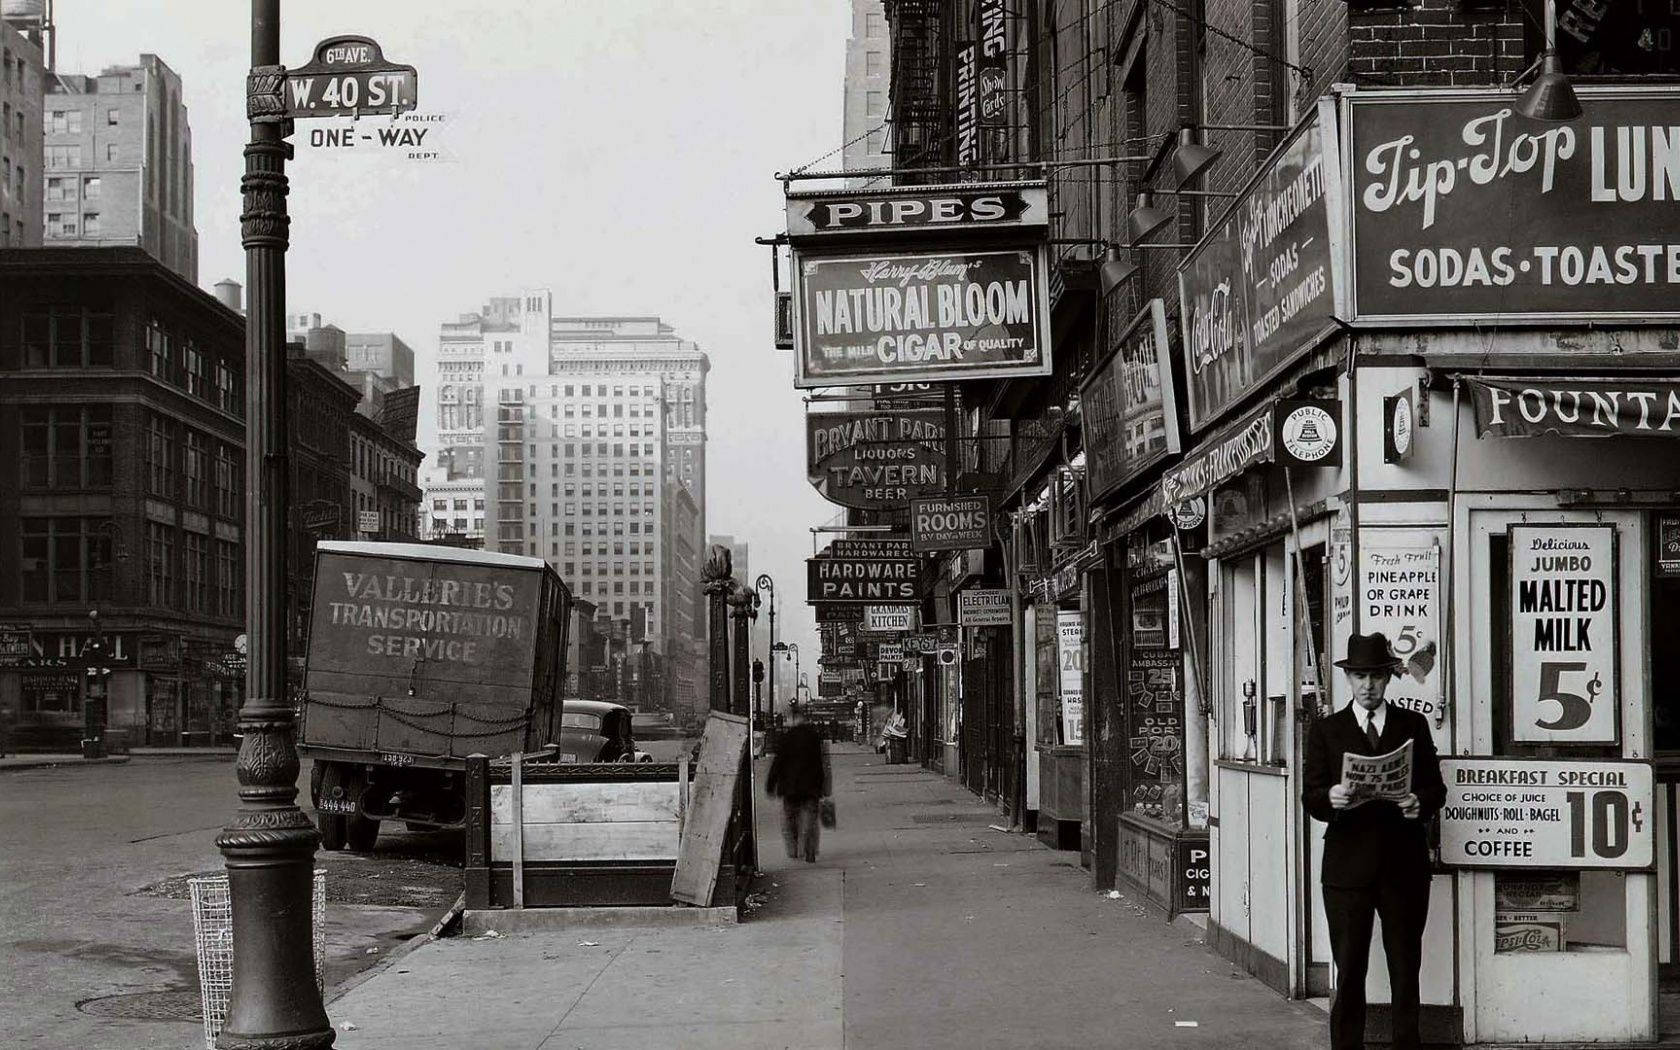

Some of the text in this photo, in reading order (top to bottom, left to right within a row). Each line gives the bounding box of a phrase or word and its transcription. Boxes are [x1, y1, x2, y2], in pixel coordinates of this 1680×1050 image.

[982, 0, 1005, 58] ING
[346, 47, 371, 64] AVE.
[290, 75, 409, 109] W. 40 ST.
[958, 45, 977, 166] PRINTING
[1363, 108, 1680, 230] Tip-Top LUN
[825, 197, 1006, 227] PIPES
[1271, 242, 1298, 288] SODAS
[1281, 266, 1326, 323] SANDWICHES
[815, 279, 1029, 335] NATURAL BLOOM
[876, 331, 963, 363] CIGAR
[978, 338, 1024, 351] QUALITY
[1291, 408, 1328, 421] PUBLIC
[1488, 386, 1680, 431] FOUNTA
[814, 417, 893, 465] BRYANT
[1286, 438, 1334, 459] TELEPHONE
[854, 448, 916, 460] LIQUORS
[830, 465, 937, 487] TAVERN
[865, 488, 907, 500] BEER
[919, 502, 981, 513] FURNISHED
[917, 512, 986, 532] ROOMS
[921, 533, 934, 541] BY
[1530, 538, 1590, 551] Delicious
[1370, 551, 1432, 566] Fresh Fruit
[1531, 556, 1591, 572] JUMBO
[819, 563, 917, 578] HARDWARE
[1368, 571, 1436, 583] PINEAPPLE
[823, 582, 915, 597] PAINTS
[1367, 589, 1430, 600] OR GRAPE
[1519, 579, 1606, 613] MALTED
[329, 602, 521, 638] TRANSPORTATION
[1369, 605, 1429, 617] DRINK
[870, 616, 909, 628] KITCHEN
[1534, 618, 1592, 651] MILK
[58, 634, 128, 660] HAL
[367, 635, 477, 662] SERVICE
[1456, 768, 1627, 786] BREAKFAST SPECIAL
[1462, 793, 1546, 803] CHOICE OF JUICE
[1464, 840, 1533, 857] COFFEE
